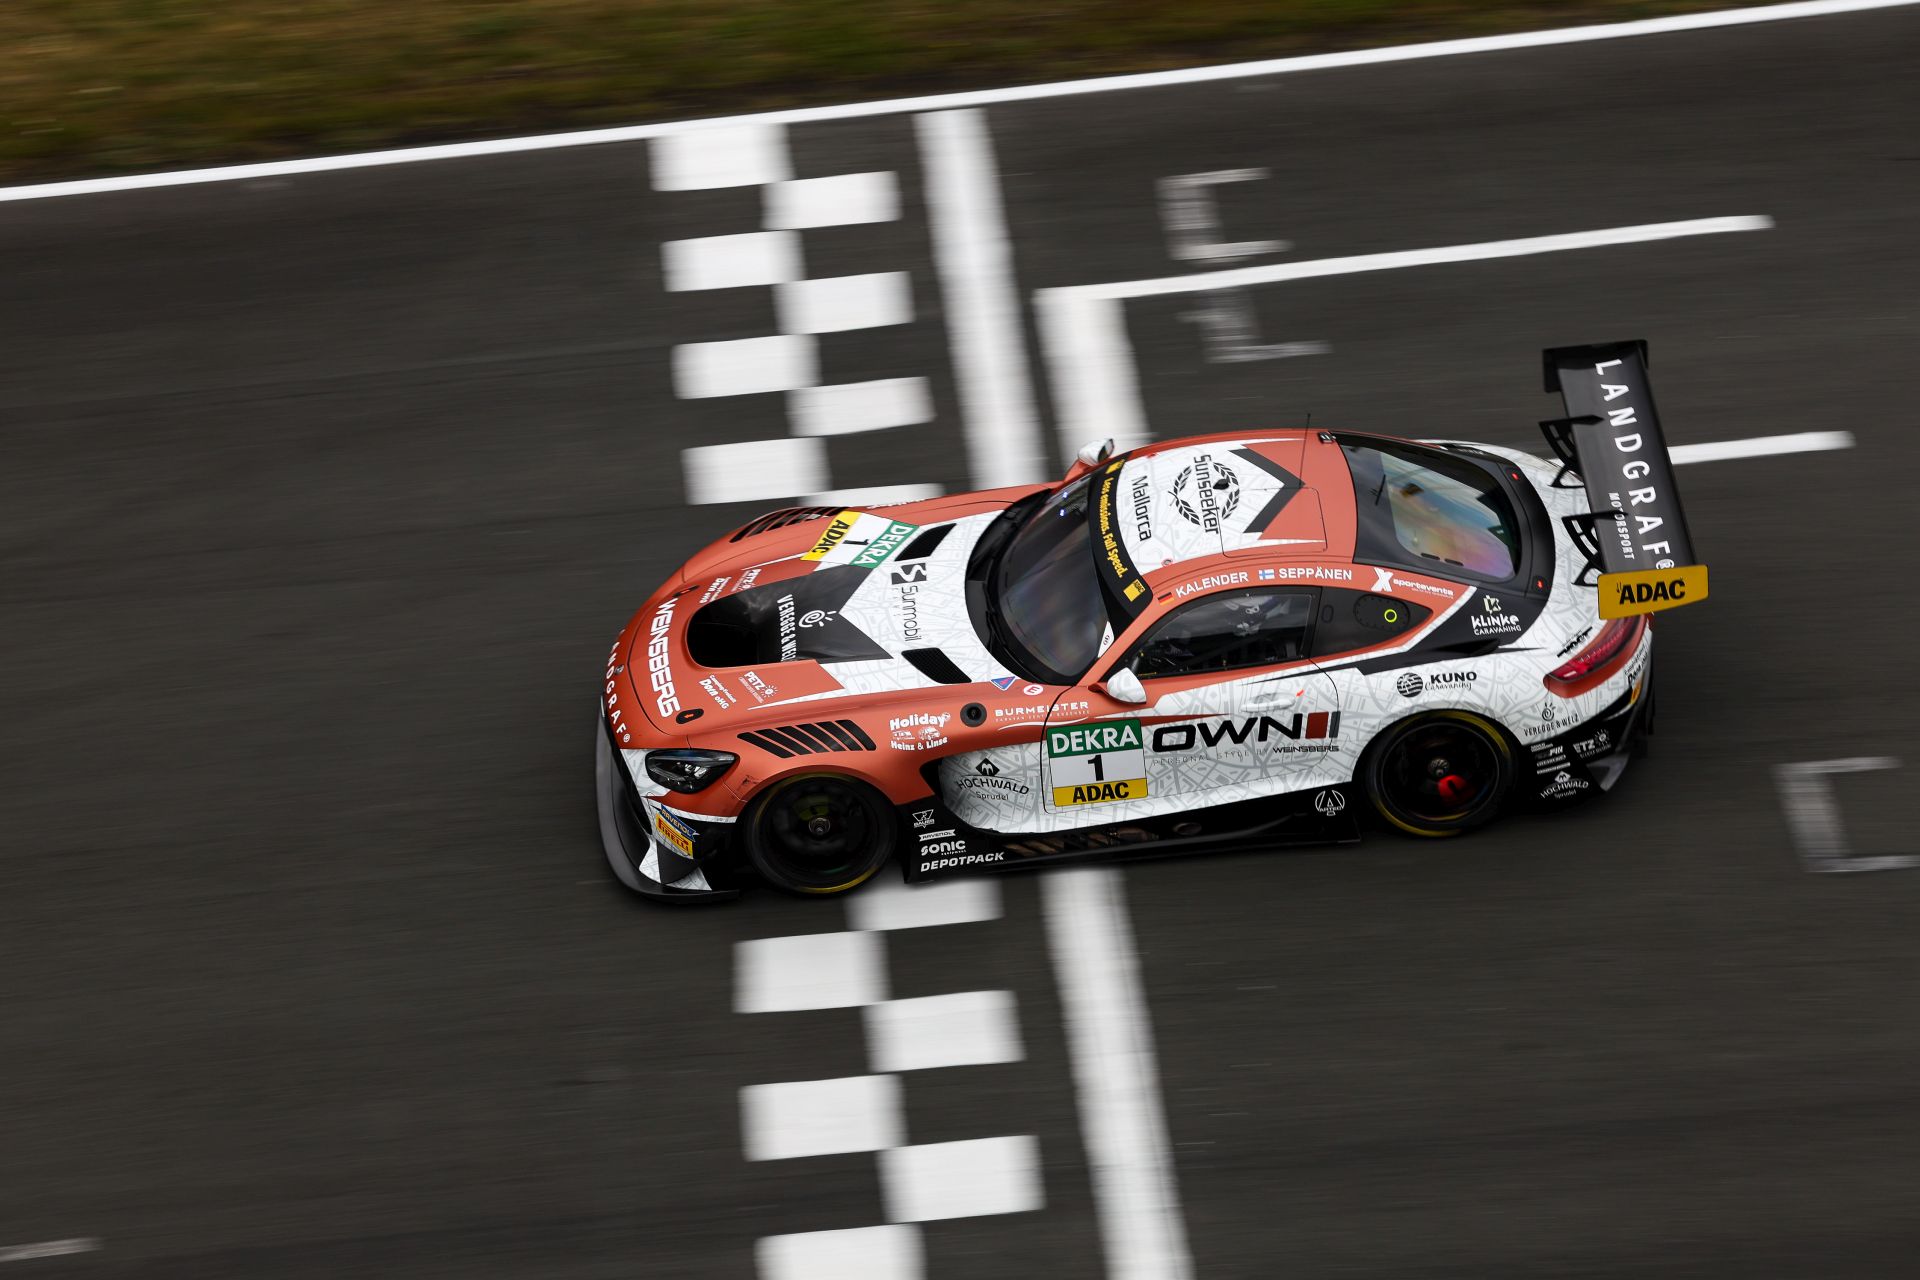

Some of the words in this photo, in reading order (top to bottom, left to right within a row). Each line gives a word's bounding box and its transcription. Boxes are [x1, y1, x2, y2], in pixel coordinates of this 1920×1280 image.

[1102, 477, 1114, 496] Less
[1194, 454, 1219, 534] Sunseeker
[1100, 495, 1112, 534] emissions.
[1132, 475, 1152, 542] Mallorca
[812, 519, 850, 554] ADAC
[843, 538, 869, 547] 1
[855, 524, 913, 565] DEKRA
[1103, 533, 1118, 551] Full
[1107, 548, 1128, 578] Speed.
[1175, 571, 1249, 598] KALENDER
[1278, 566, 1353, 581] SEPPÄNEN
[1619, 579, 1686, 605] ADAC
[777, 594, 797, 638] VEREGGE
[901, 585, 922, 642] Sunmobil
[1474, 625, 1522, 636] CARAVANING
[648, 598, 681, 718] WEINSBERG
[744, 671, 766, 691] PETZ
[1430, 671, 1477, 684] KUNO
[994, 701, 1089, 717] BURMEISTER
[889, 714, 946, 731] Holiday
[891, 740, 915, 751] Heinz
[917, 742, 924, 750] &
[926, 737, 948, 749] Linse
[1051, 725, 1139, 754] DEKRA
[1272, 745, 1340, 753] WEINSBERG
[1087, 754, 1104, 782] 1
[956, 778, 1030, 795] HOCHWALD
[976, 791, 1009, 801] Sprudel
[1072, 783, 1130, 803] ADAC
[1540, 780, 1589, 798] HOCHWALD
[662, 808, 692, 837] RAVENOL
[658, 817, 689, 852] PIRELLI
[922, 832, 953, 840] RAVENOL
[921, 851, 1005, 872] DEPOTPACK
